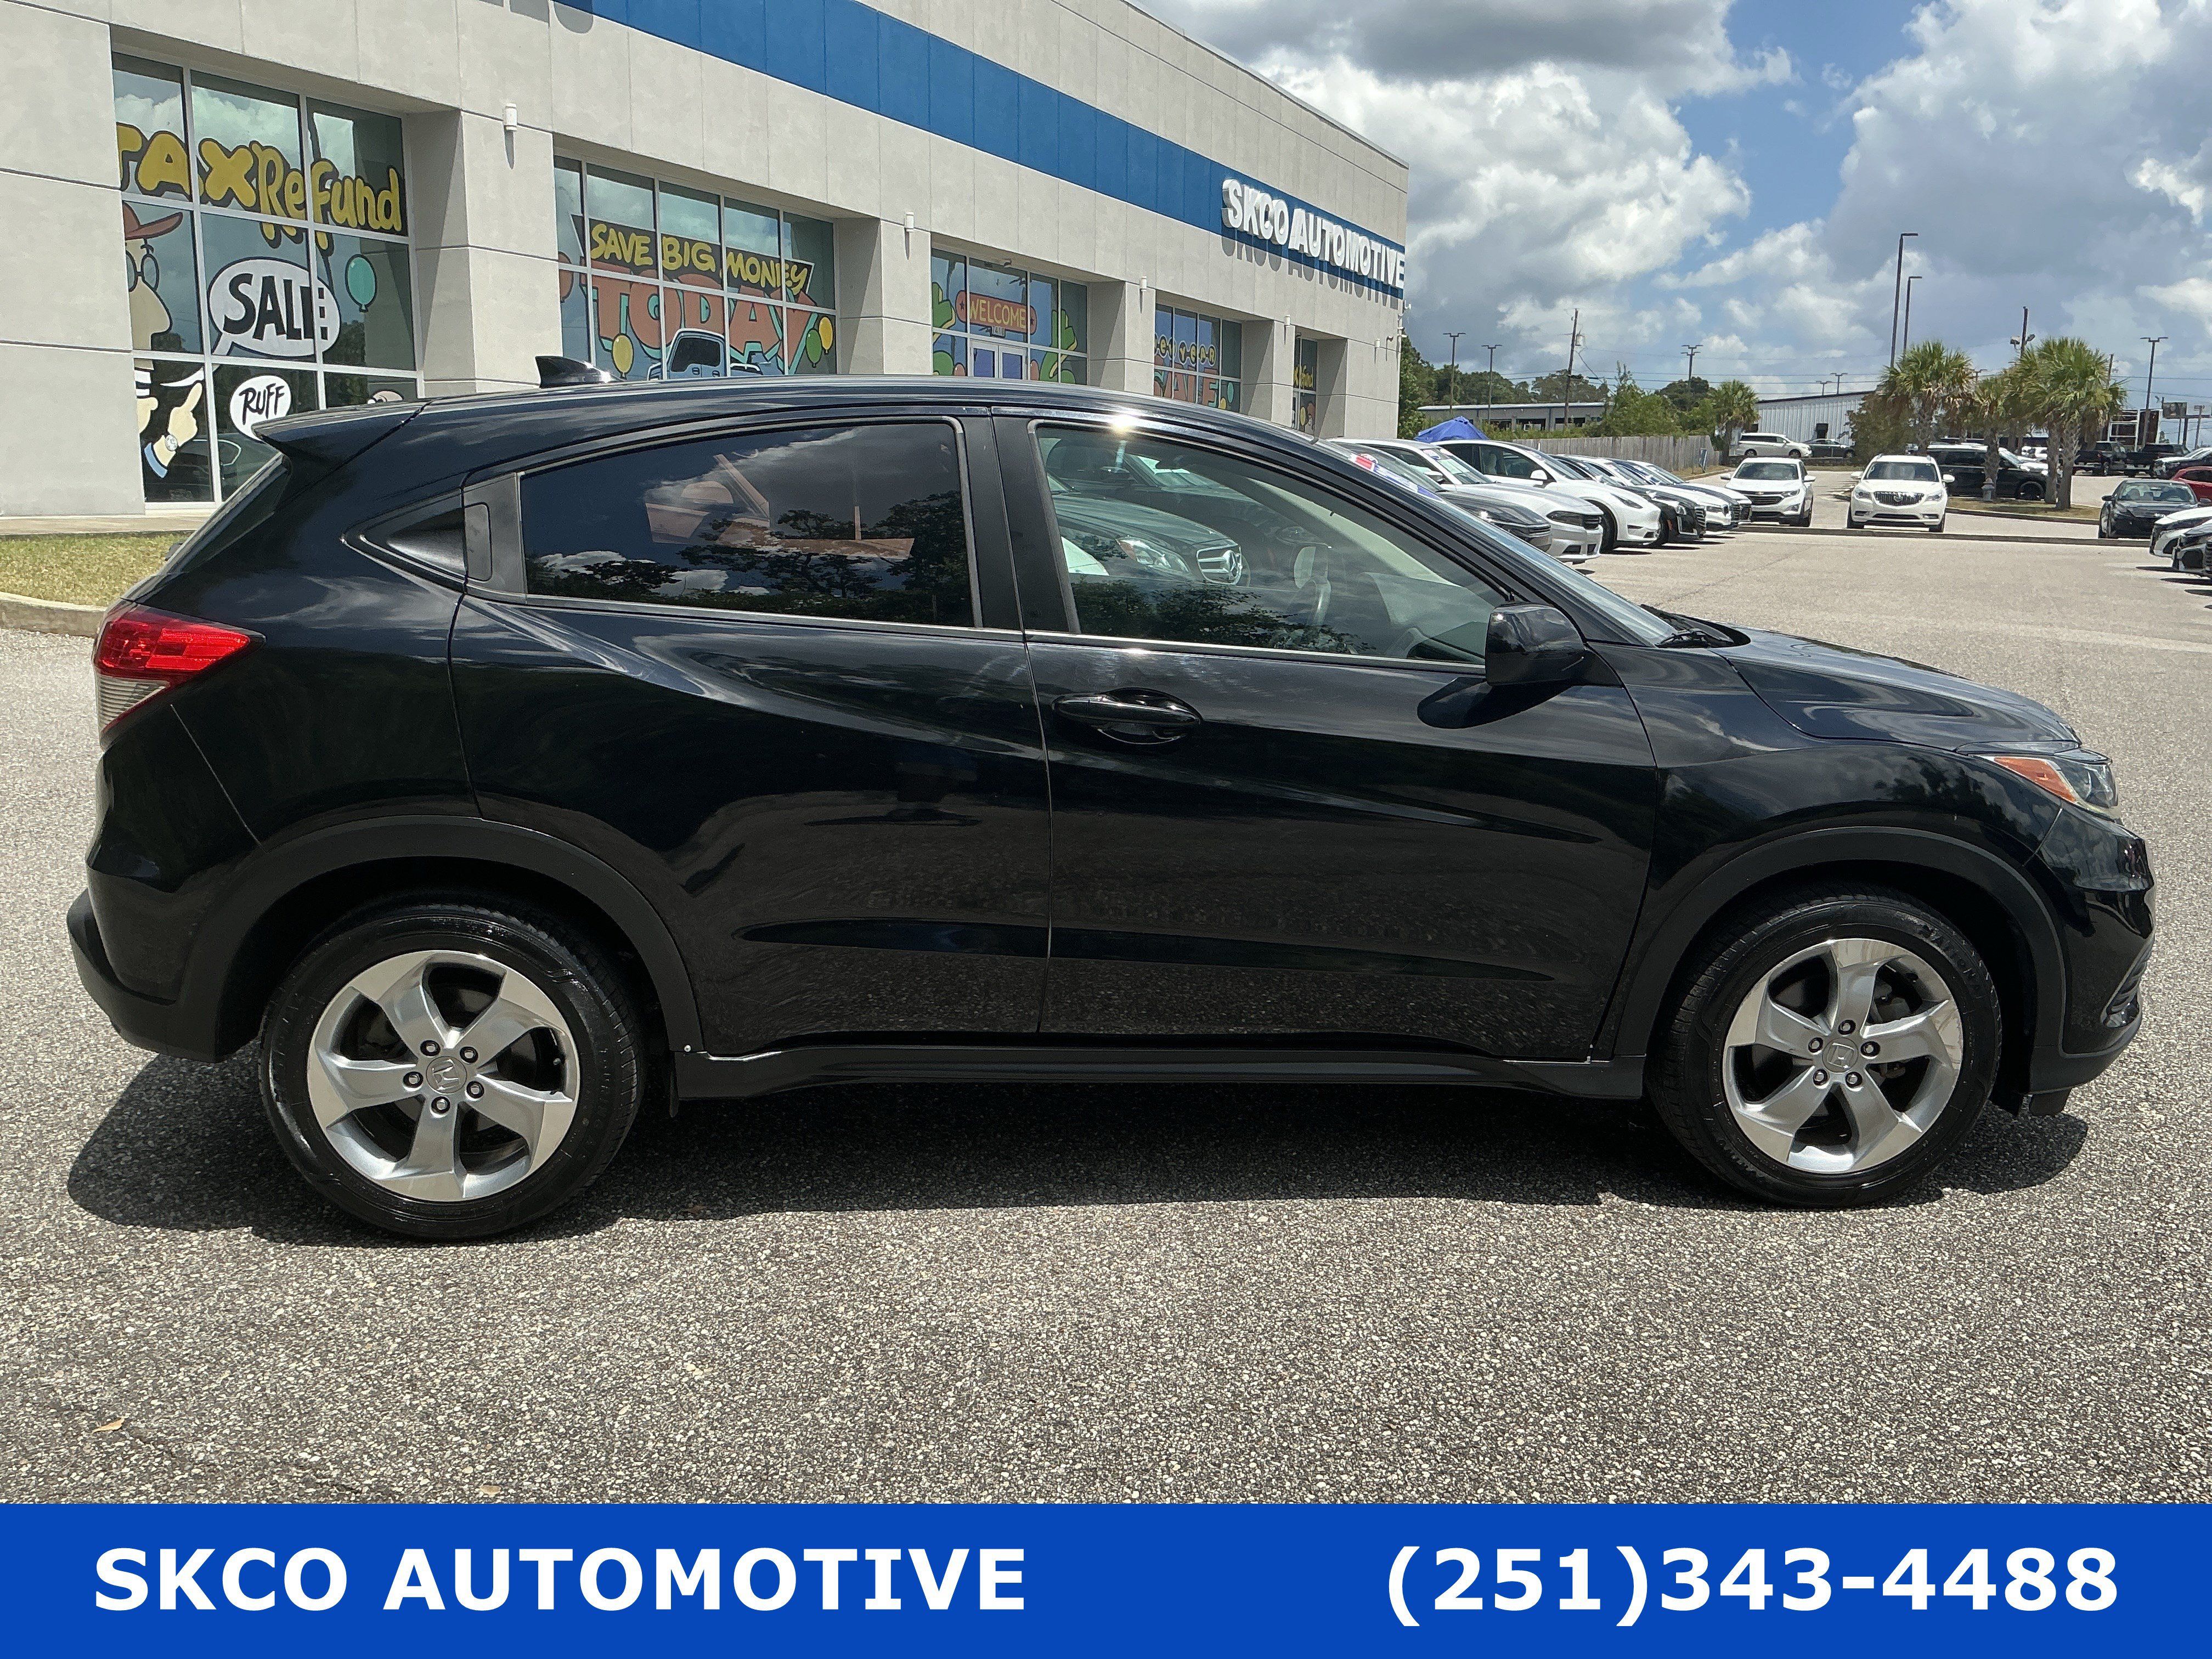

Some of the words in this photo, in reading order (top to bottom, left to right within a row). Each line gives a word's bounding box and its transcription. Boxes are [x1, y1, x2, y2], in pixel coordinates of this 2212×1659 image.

[251, 142, 405, 253] Refund
[590, 223, 653, 267] SAVE
[662, 236, 716, 272] BIG
[1222, 179, 1289, 245] SKCO
[1288, 208, 1404, 289] AUTOMOTIVE
[224, 273, 329, 340] SALE
[580, 257, 819, 376] TODAY
[970, 298, 1026, 329] WELCOME
[238, 383, 285, 424] RUFF
